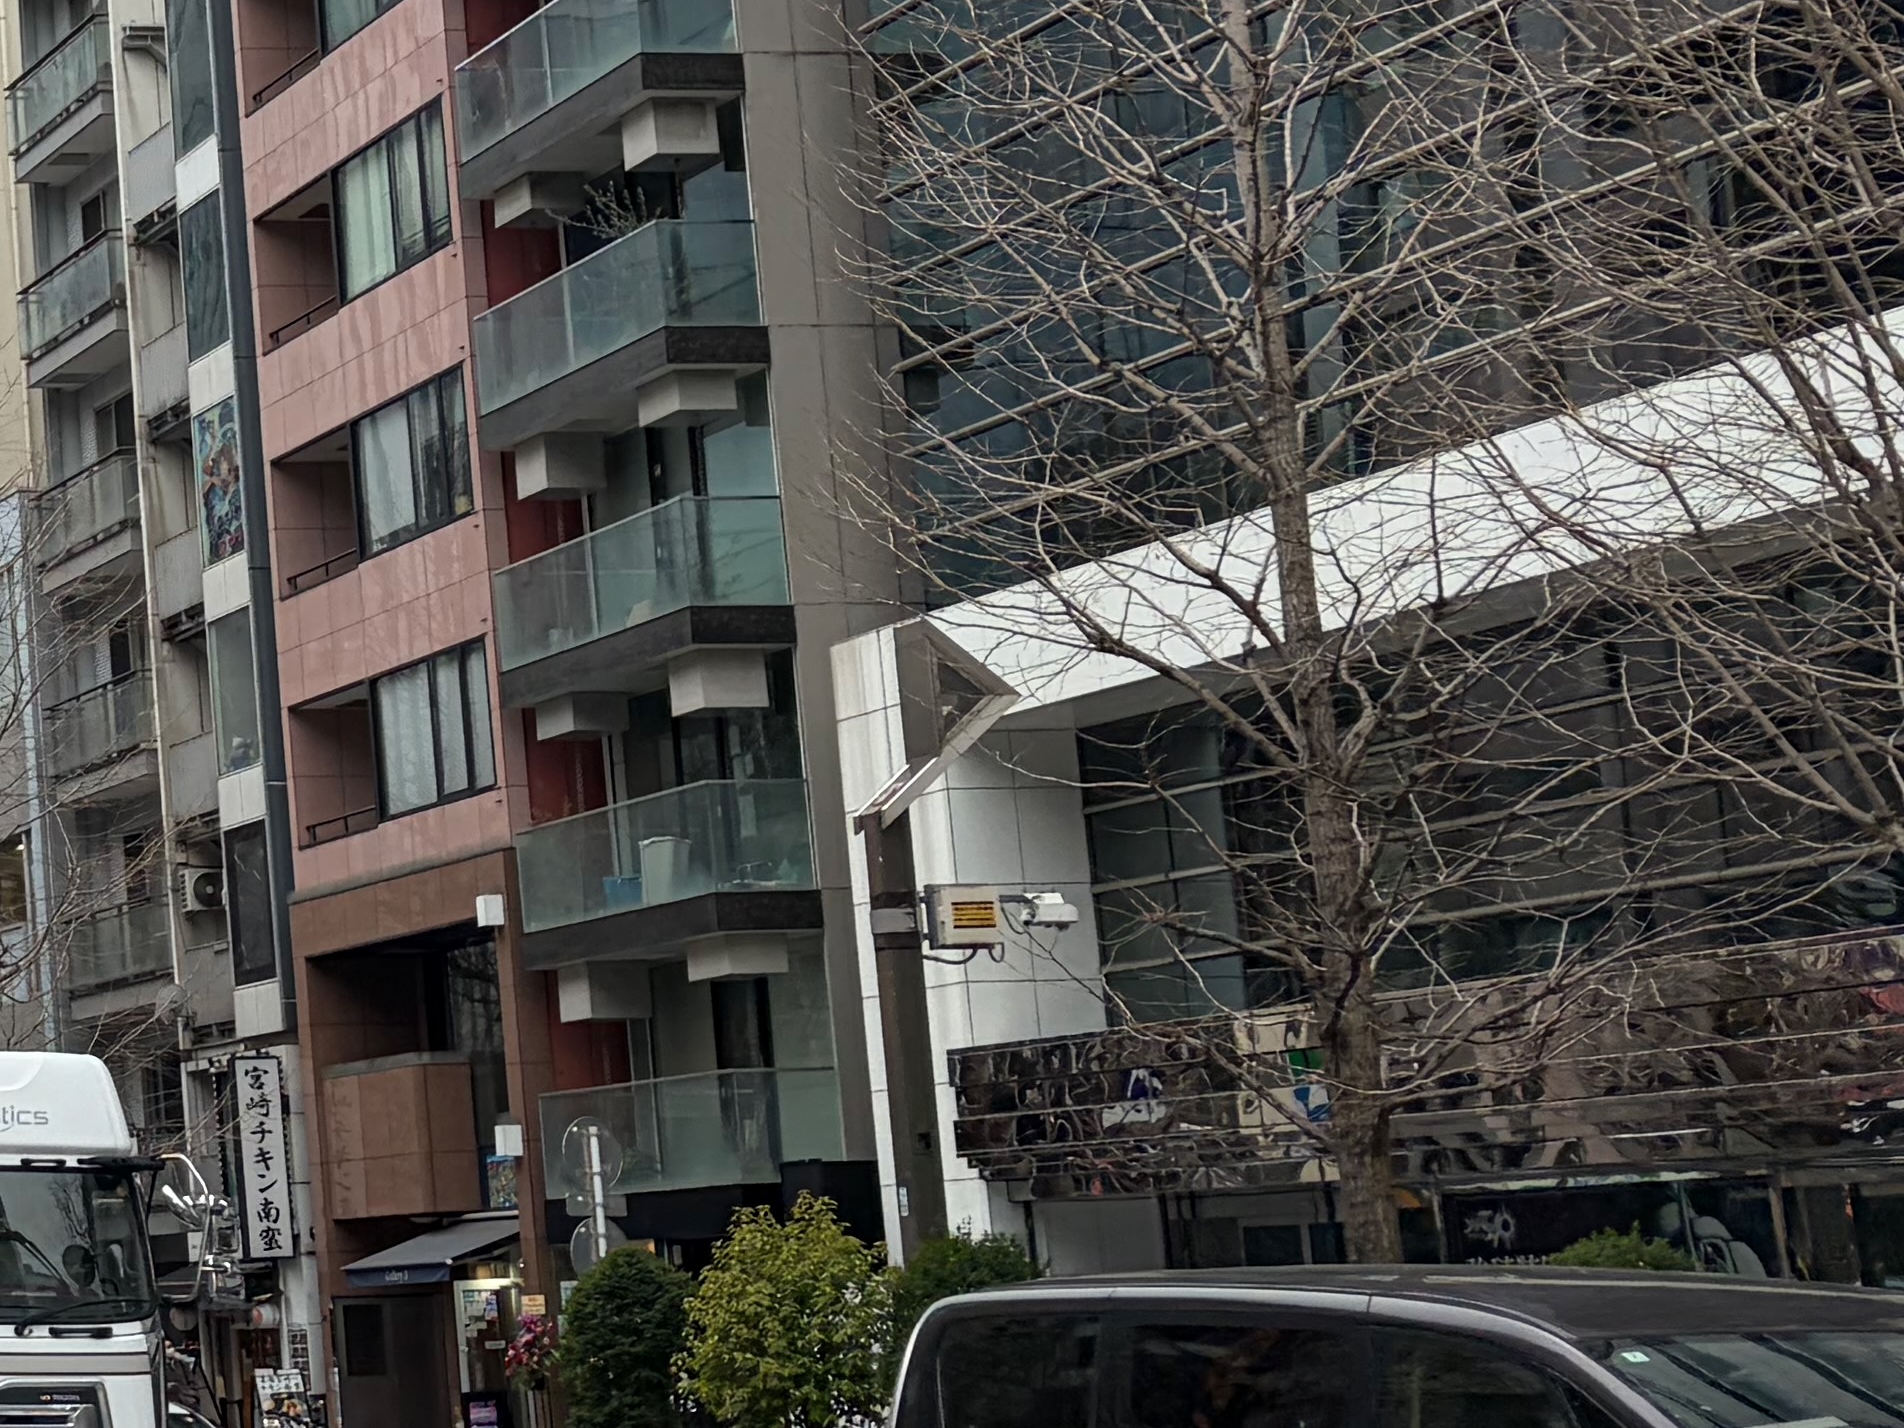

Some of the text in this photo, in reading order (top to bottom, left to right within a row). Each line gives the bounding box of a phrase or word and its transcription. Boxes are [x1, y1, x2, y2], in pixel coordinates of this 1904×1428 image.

[242, 1064, 284, 1253] 宮崎チキン南蛮
